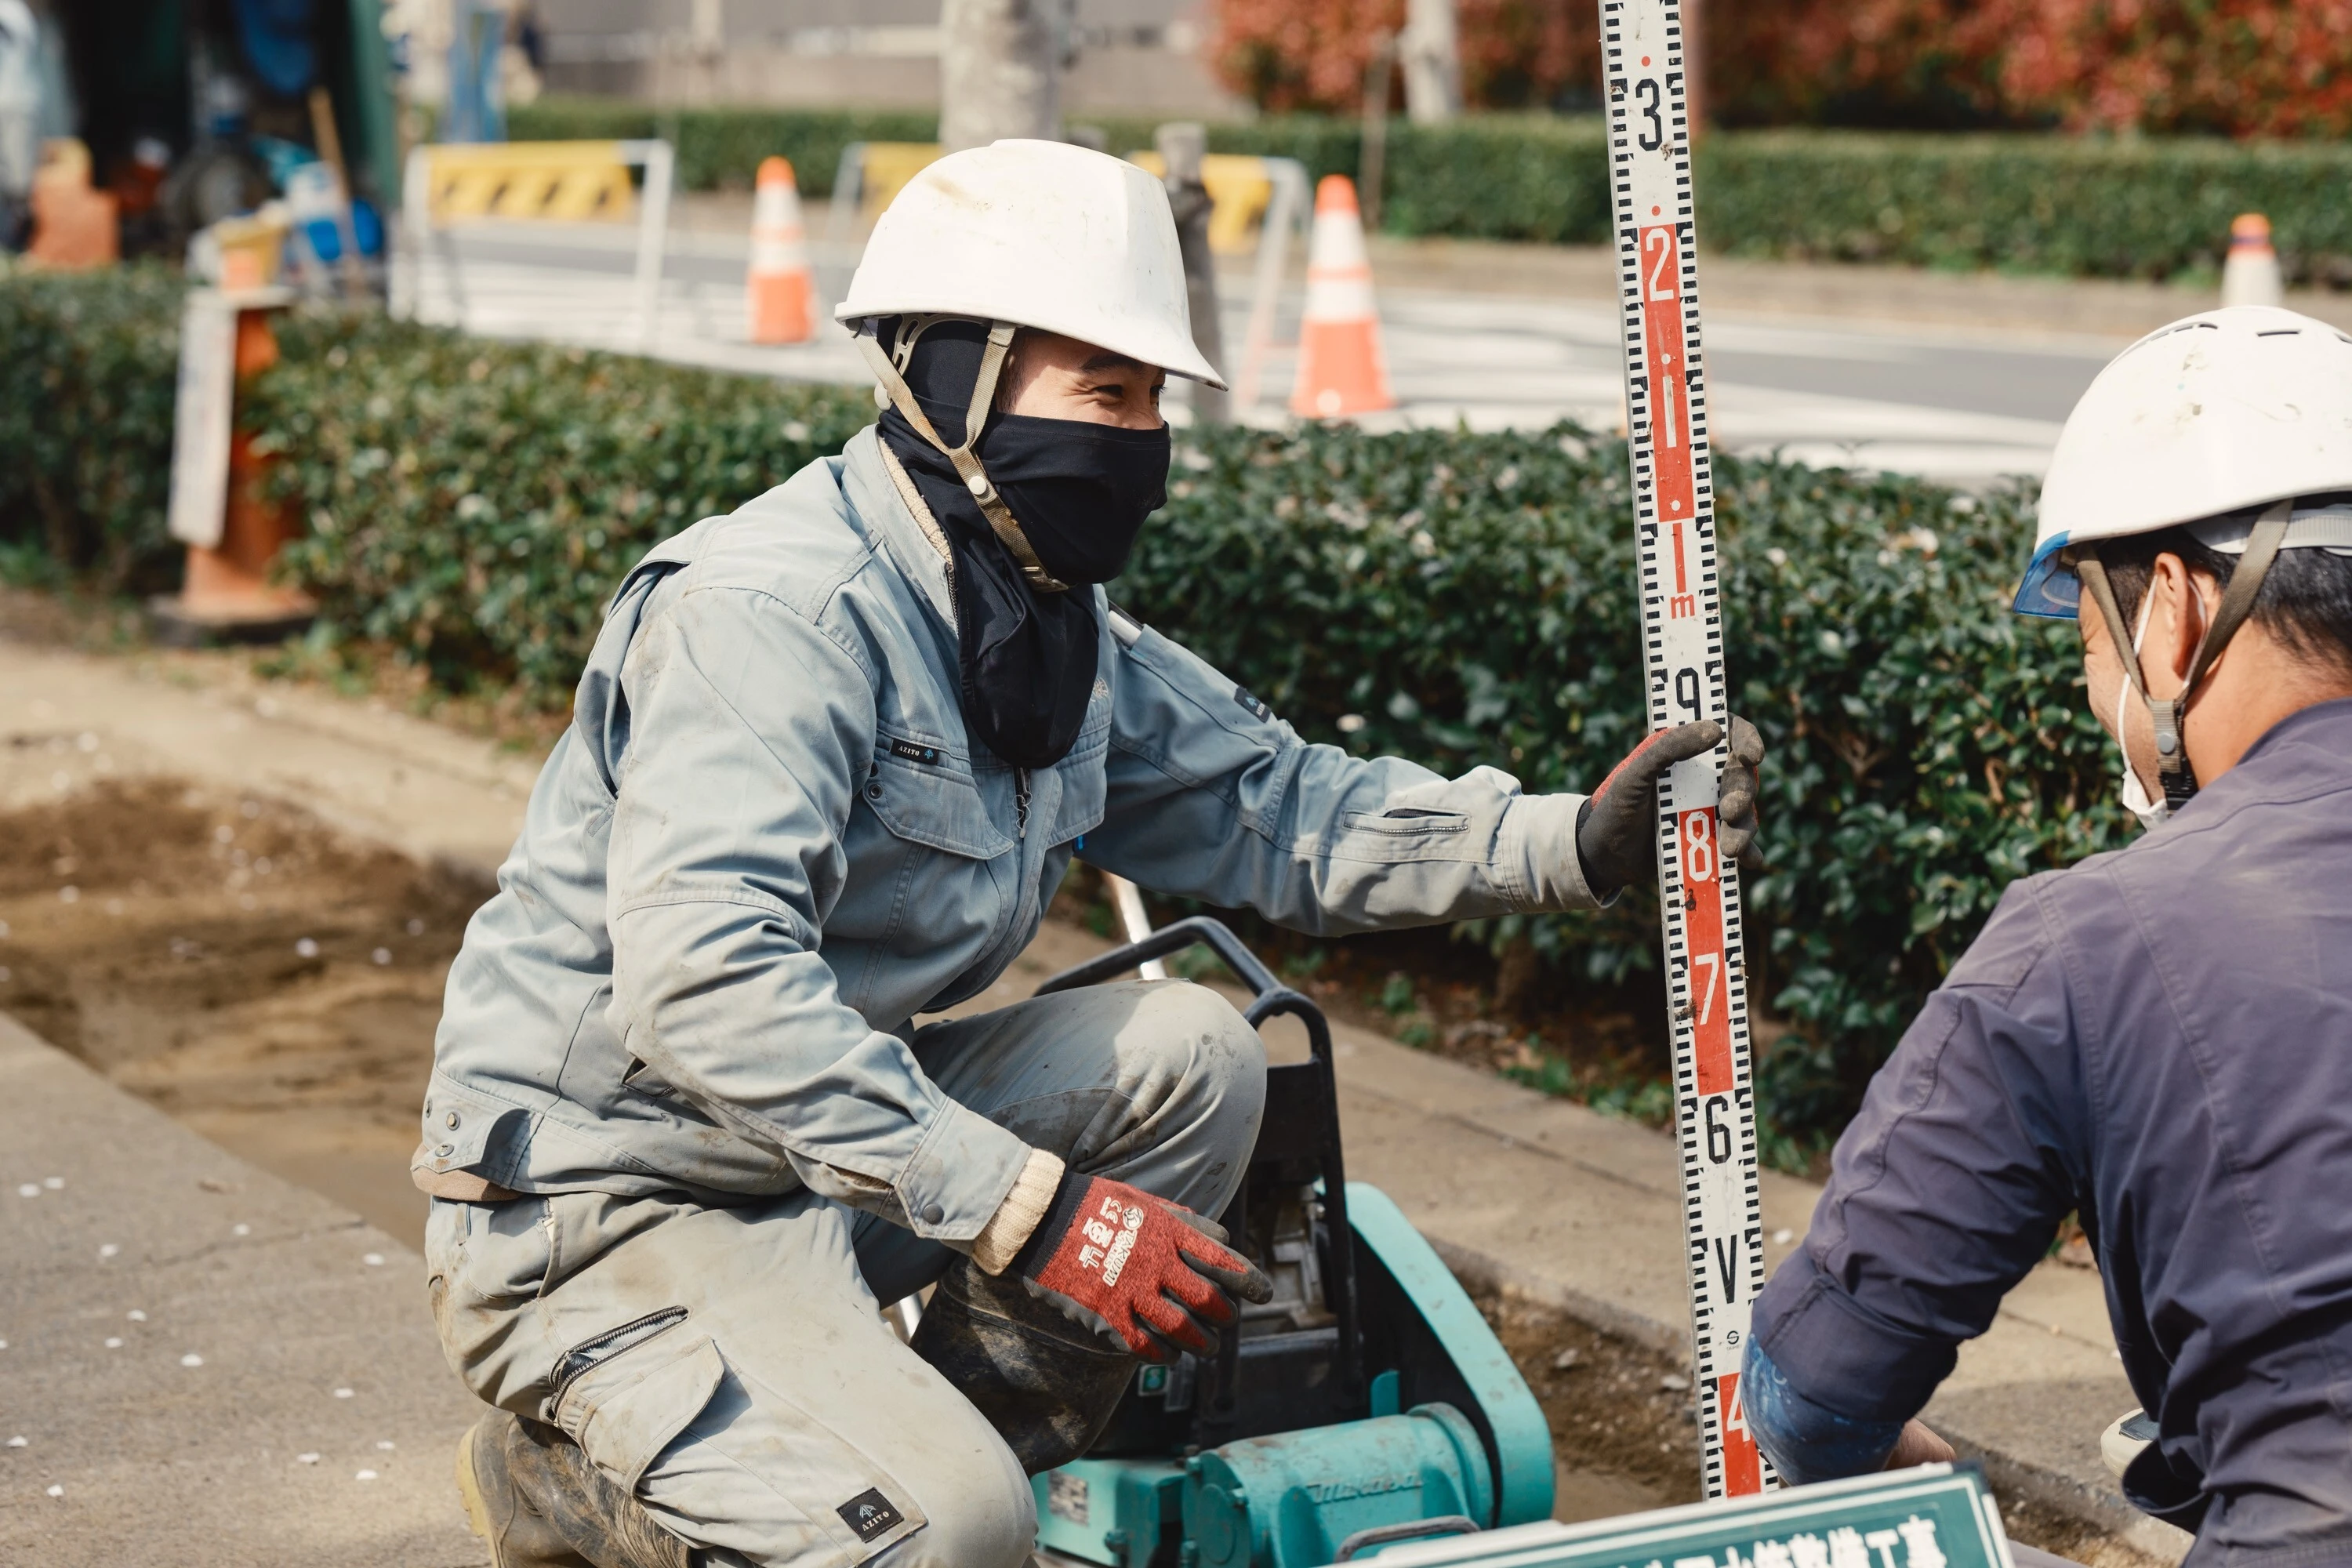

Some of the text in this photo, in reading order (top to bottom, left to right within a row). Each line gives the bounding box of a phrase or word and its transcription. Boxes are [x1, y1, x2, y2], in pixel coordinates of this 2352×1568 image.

[1635, 78, 1663, 151] 3
[1646, 227, 1675, 302] 2
[1670, 593, 1696, 619] m
[1675, 667, 1702, 725] 9
[898, 745, 920, 757] AZITO
[1686, 811, 1713, 883] 8
[1695, 952, 1719, 1025] 7
[1705, 1095, 1732, 1164] 6
[1104, 1231, 1137, 1285] TAKUMI
[1715, 1234, 1737, 1304] V
[1726, 1376, 1751, 1442] 4
[862, 1511, 890, 1531] AZITO
